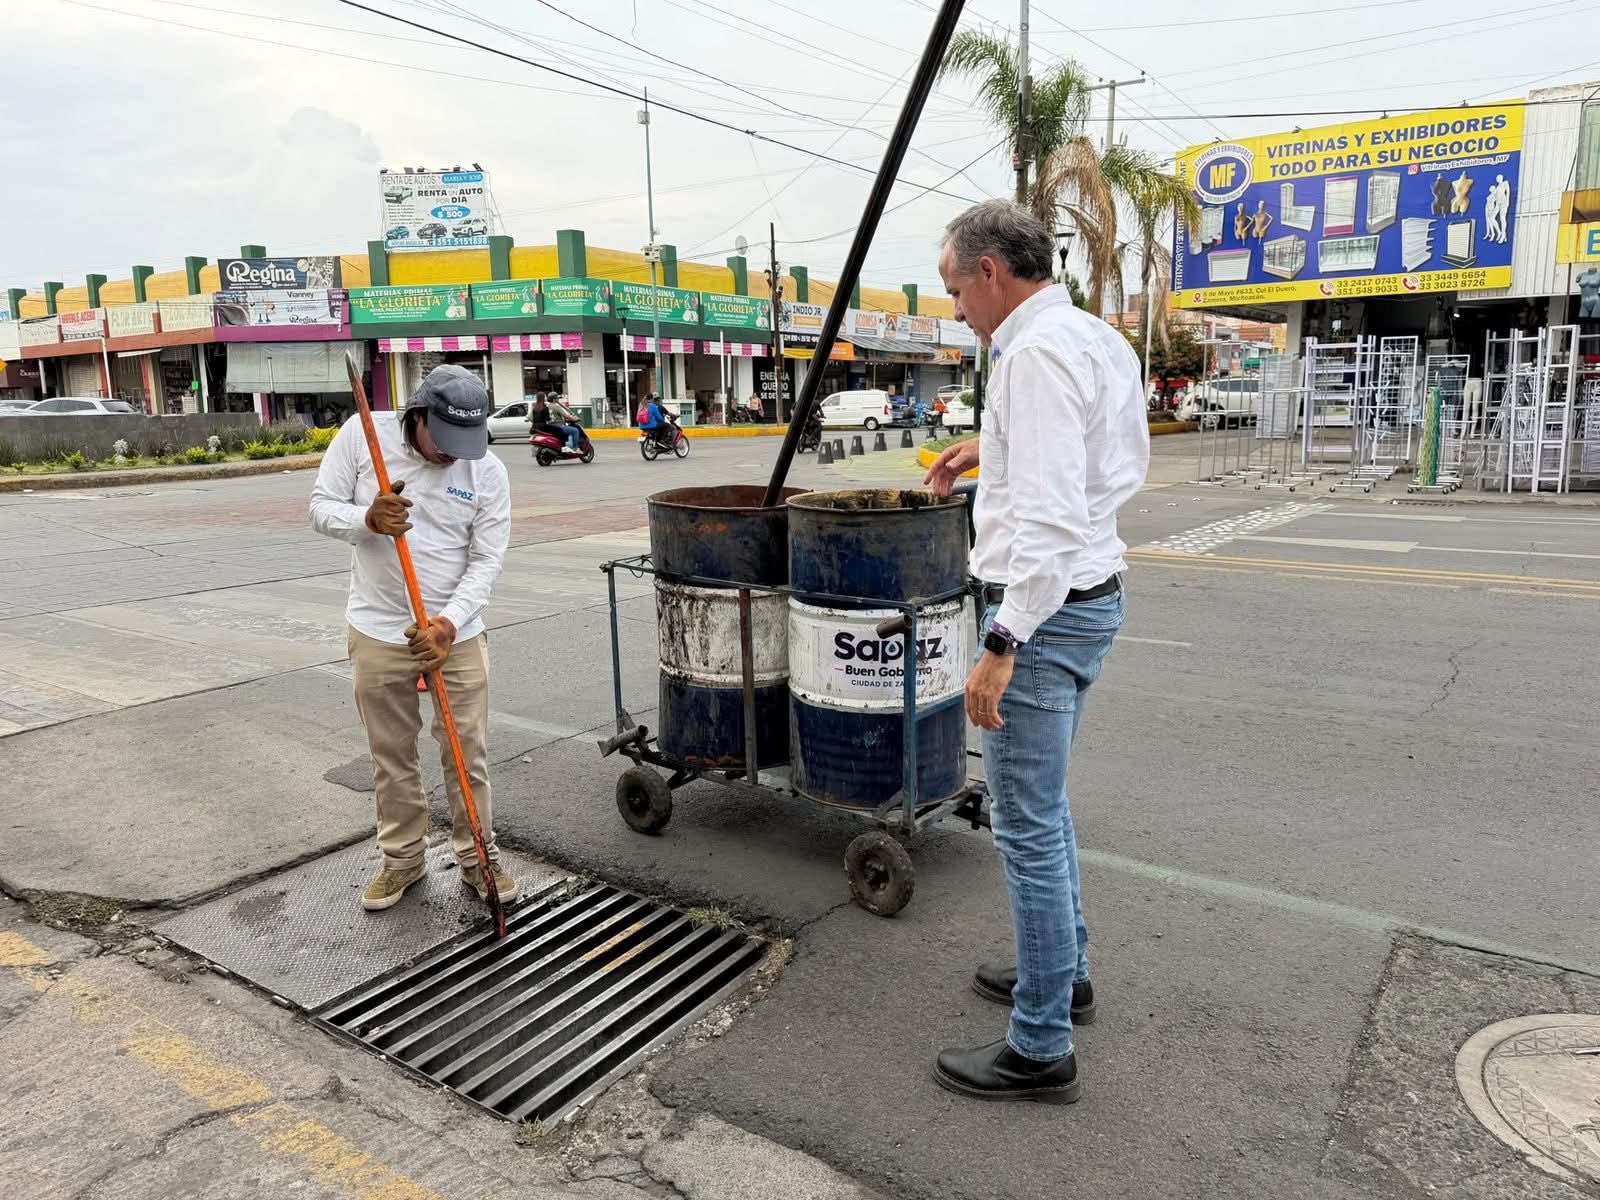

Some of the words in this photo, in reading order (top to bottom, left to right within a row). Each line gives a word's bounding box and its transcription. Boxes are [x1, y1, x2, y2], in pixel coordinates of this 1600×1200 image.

[1267, 136, 1349, 159] VITRINAS
[1354, 133, 1366, 148] Y
[1371, 114, 1507, 145] EXHIBIDORES
[1269, 159, 1317, 178] TODO
[1322, 152, 1371, 171] PARA
[1377, 148, 1403, 164] SU
[1408, 136, 1500, 161] NEGOCIO
[1210, 163, 1236, 189] MF
[459, 188, 483, 196] AUTO
[226, 261, 296, 285] Regina
[1419, 274, 1432, 282] 33
[1434, 273, 1459, 281] 3449
[1461, 271, 1486, 279] 6654
[1336, 280, 1349, 288] 33
[1350, 279, 1373, 287] 2417
[1375, 277, 1397, 285] 0743
[1419, 282, 1432, 290] 33
[1434, 281, 1458, 289] 3023
[1460, 279, 1485, 287] 8726
[1336, 288, 1353, 296] 351
[1375, 285, 1398, 293] 9033
[793, 305, 813, 315] INDIO
[448, 405, 481, 418] Sapaz
[446, 486, 474, 501] SAPAZ
[845, 664, 876, 677] Buen
[851, 680, 881, 688] CIUDAD
[895, 679, 926, 688] ZARA
